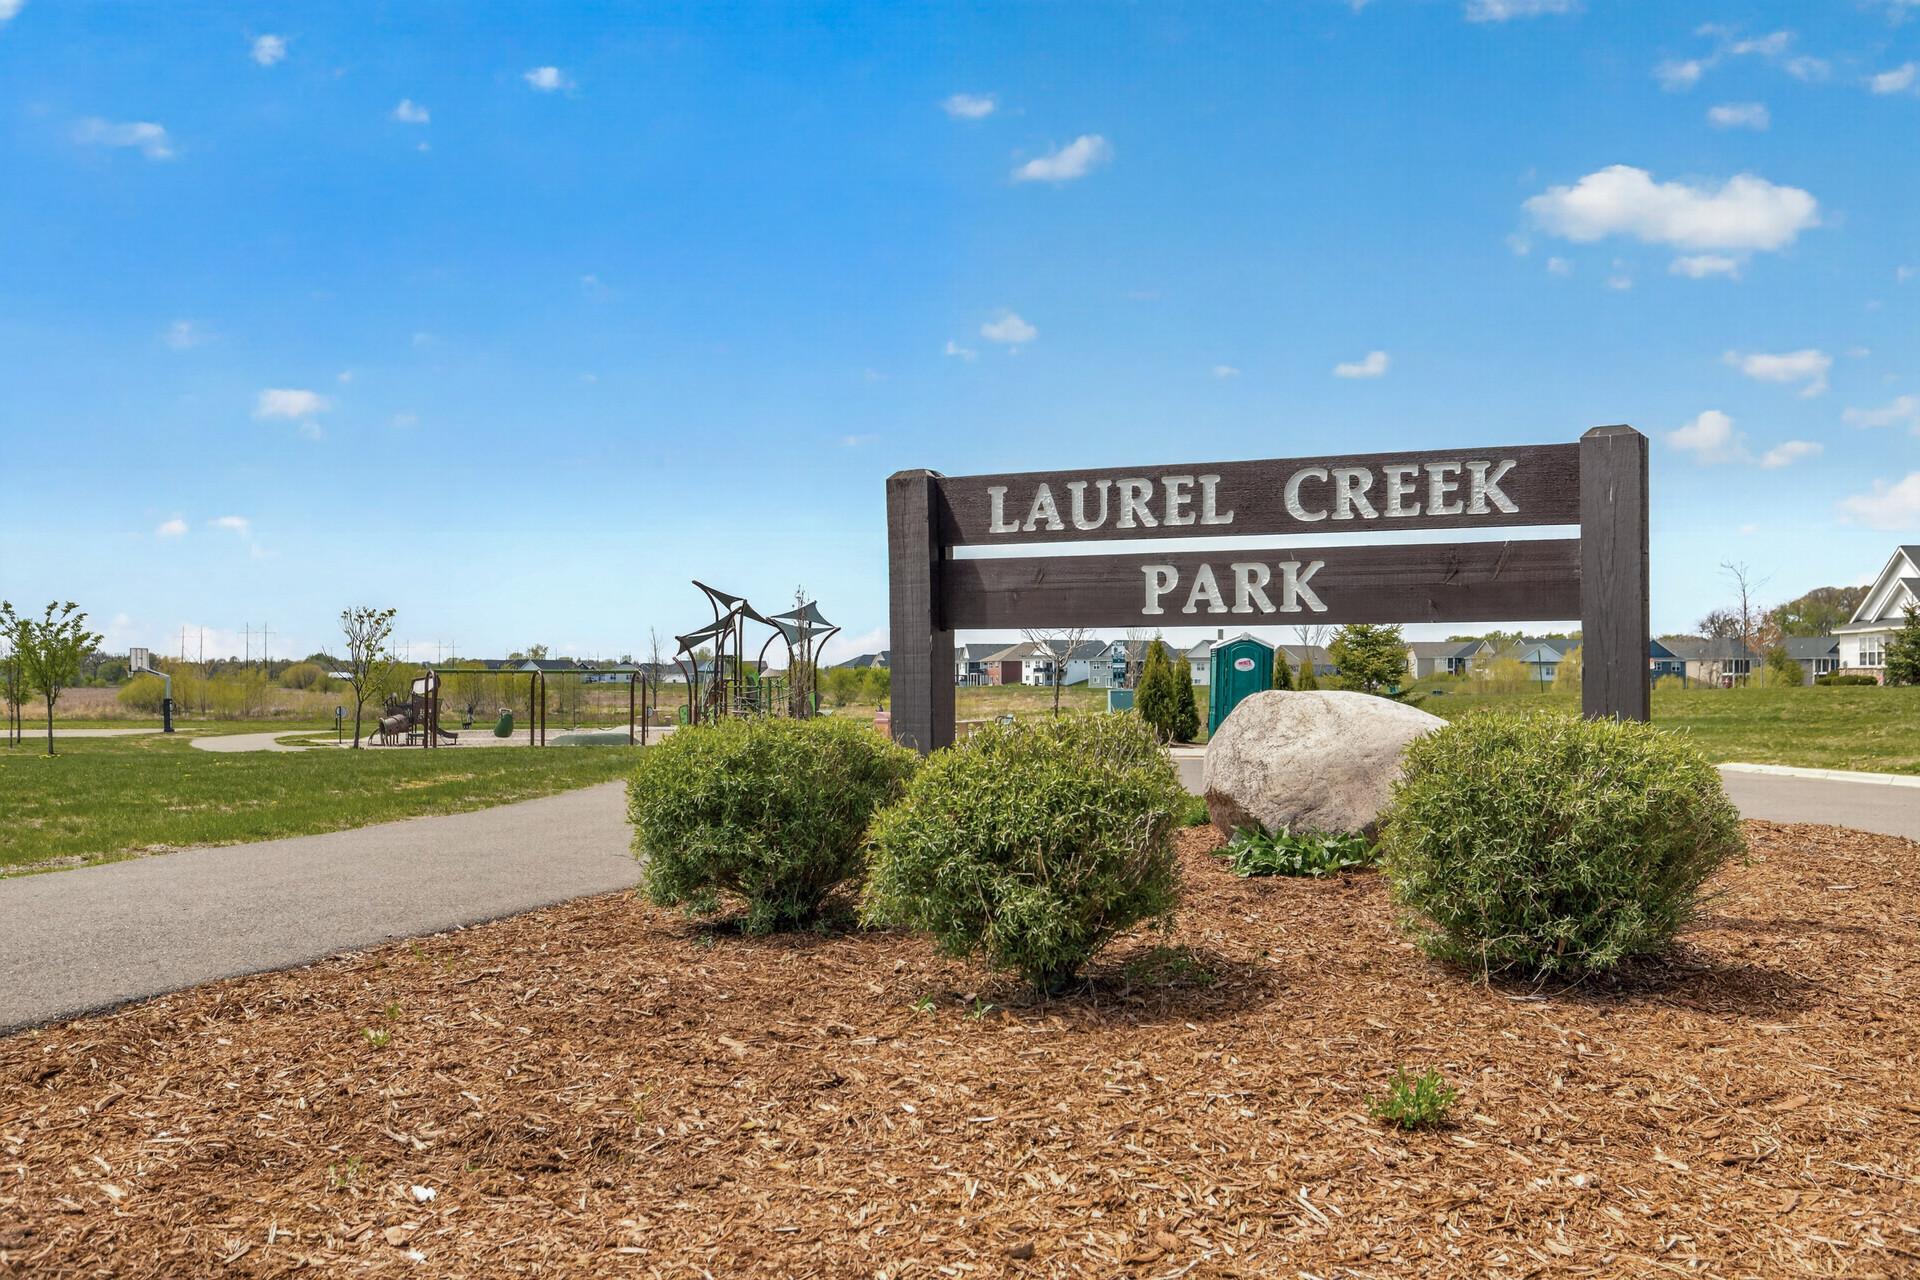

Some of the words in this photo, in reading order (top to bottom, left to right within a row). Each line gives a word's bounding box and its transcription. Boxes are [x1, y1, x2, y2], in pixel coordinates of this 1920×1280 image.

[987, 475, 1234, 533] LAUREL
[1283, 459, 1520, 522] CREEK
[1140, 560, 1328, 615] PARK
